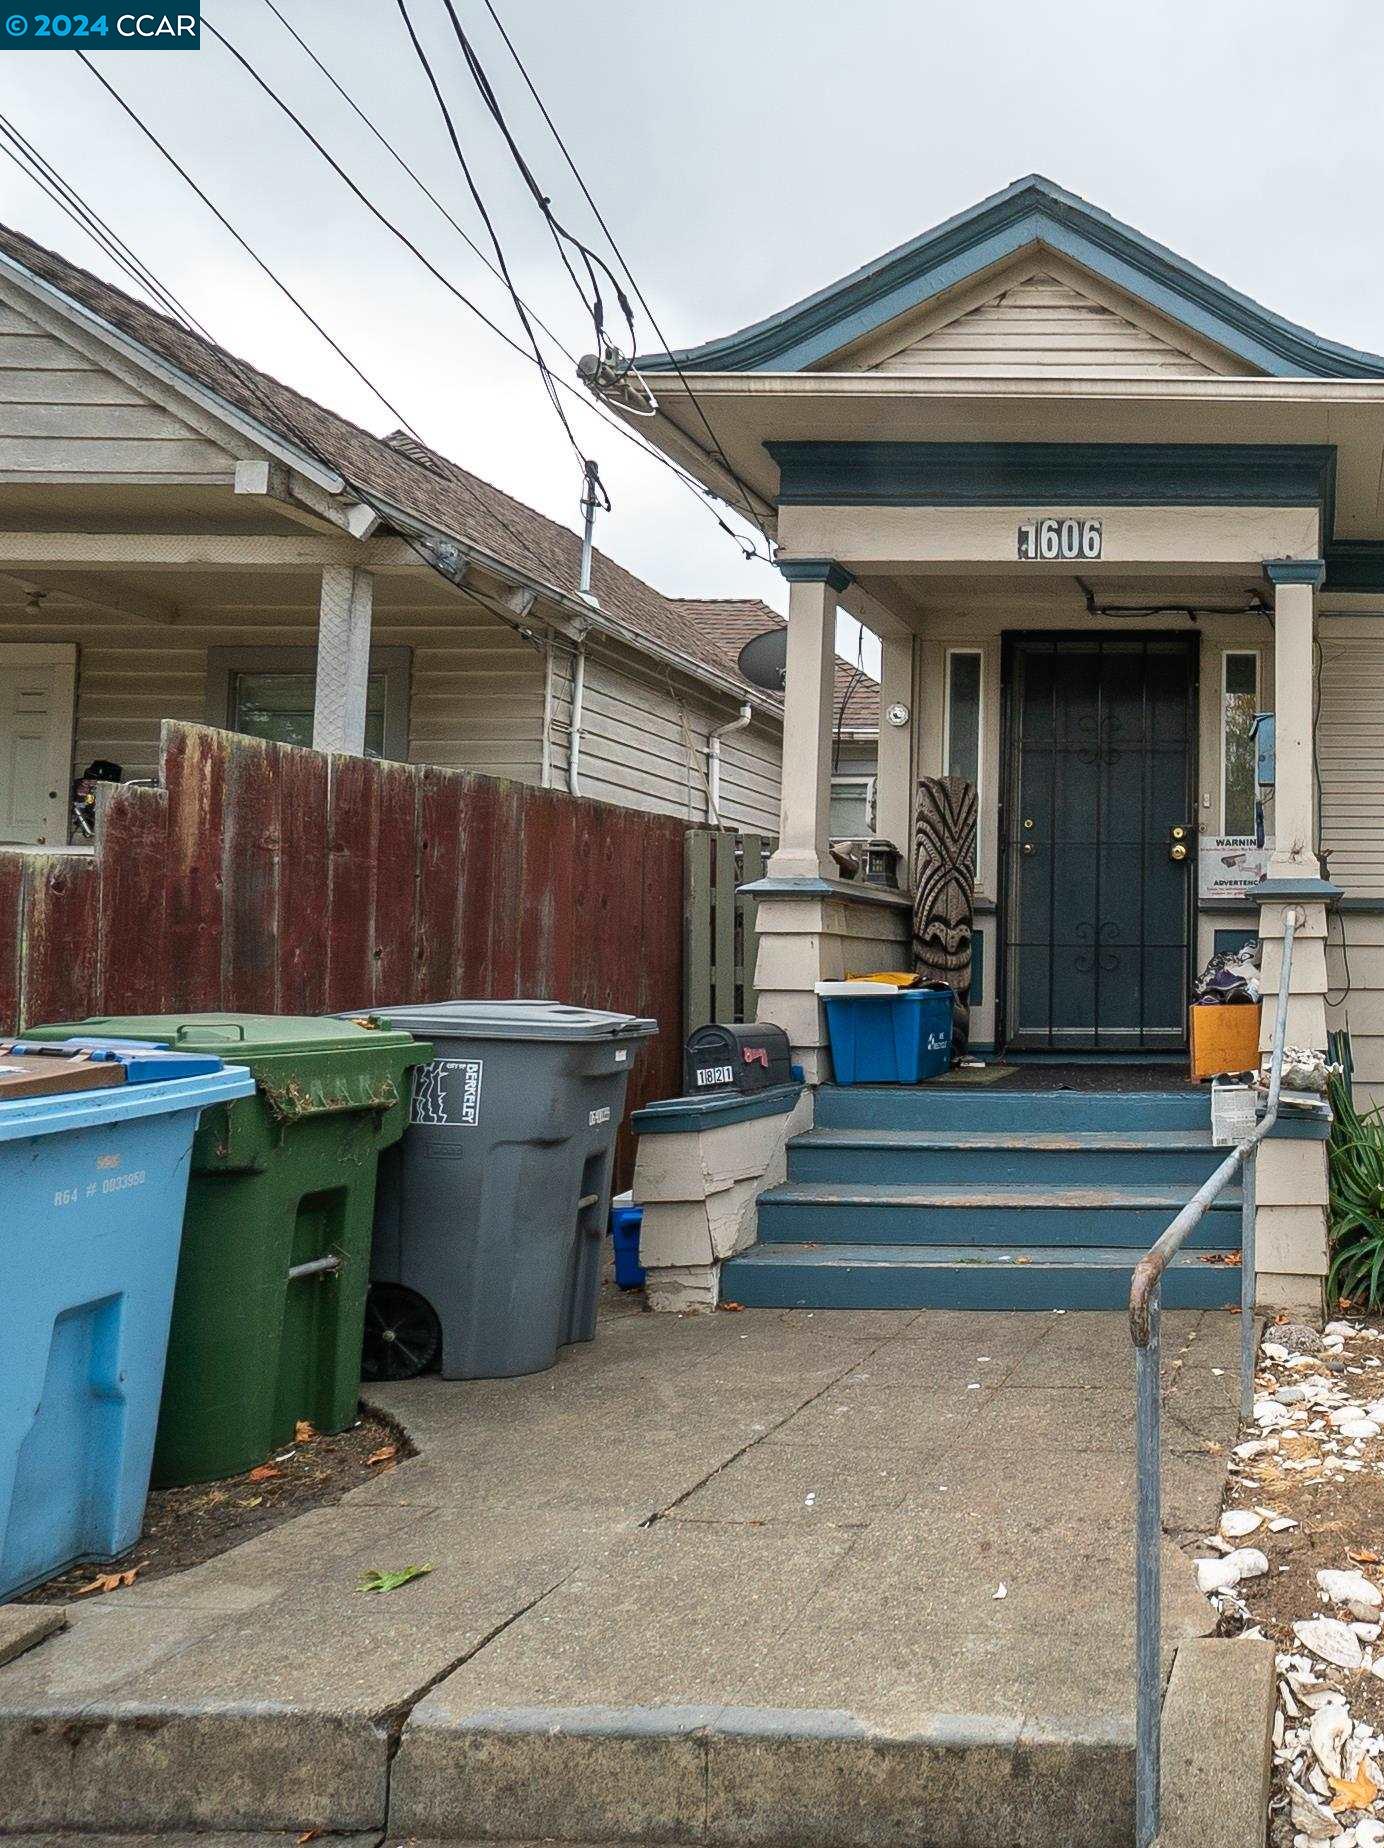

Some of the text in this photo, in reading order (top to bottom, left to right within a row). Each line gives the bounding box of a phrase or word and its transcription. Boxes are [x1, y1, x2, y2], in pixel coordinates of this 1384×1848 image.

[1020, 519, 1101, 558] 1606
[461, 1063, 479, 1123] BERKELEY
[698, 1066, 732, 1084] 1821
